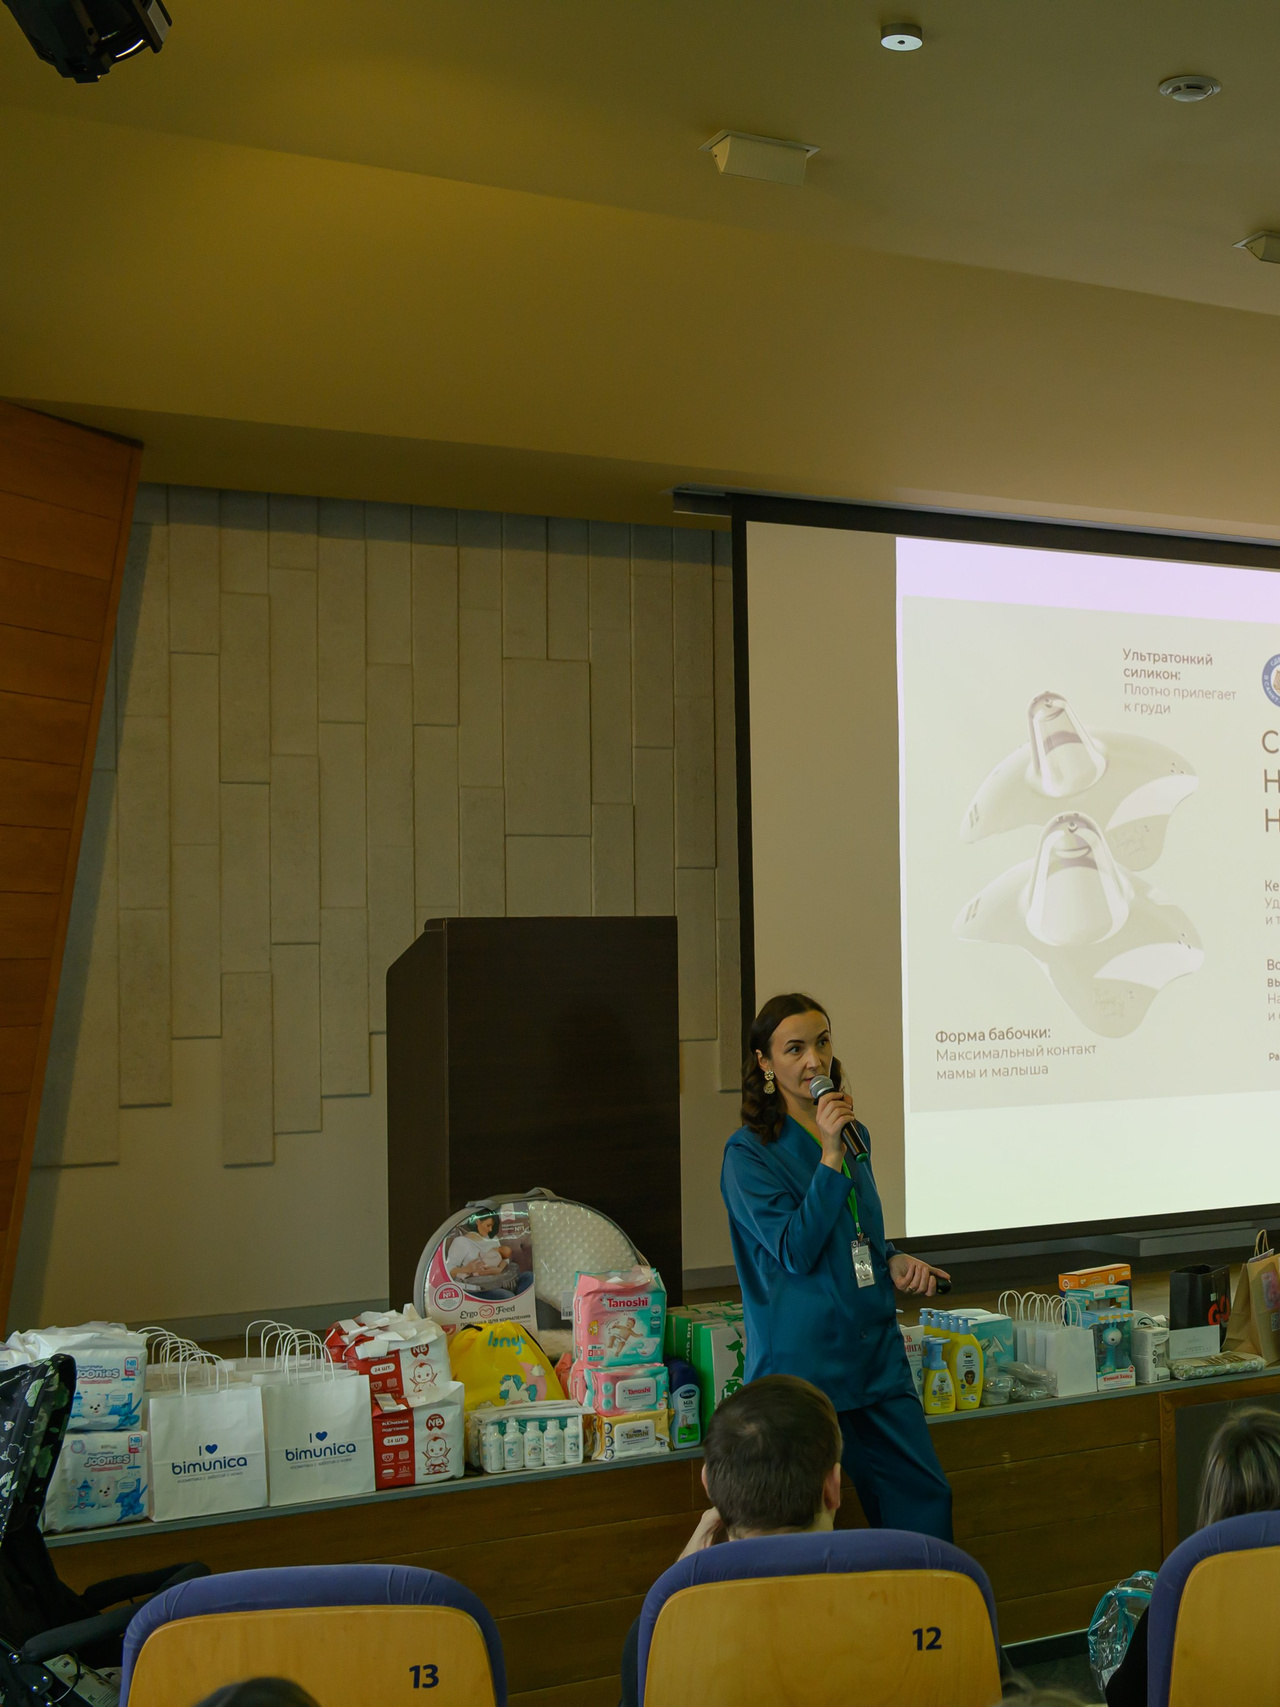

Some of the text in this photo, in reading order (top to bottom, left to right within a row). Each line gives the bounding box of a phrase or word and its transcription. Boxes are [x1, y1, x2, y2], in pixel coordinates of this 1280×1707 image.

[1123, 648, 1213, 666] Ультратонкий
[1123, 668, 1181, 680] силикон:
[1124, 683, 1237, 701] Плотно прилегает
[1124, 702, 1171, 715] к груди
[1265, 916, 1273, 925] и
[1268, 1012, 1275, 1021] и
[935, 1027, 1051, 1045] Форма бабочки:
[936, 1044, 1097, 1062] Максимальный контакт
[936, 1064, 1049, 1080] мамы и малыша
[607, 1297, 648, 1308] Tanoshi
[459, 1305, 516, 1320] Ergo Feed
[427, 1417, 443, 1428] NB
[309, 1432, 313, 1443] I
[199, 1445, 202, 1456] I
[285, 1443, 356, 1461] bimunica
[171, 1456, 247, 1475] bimunica
[912, 1626, 943, 1651] 12
[408, 1664, 440, 1689] 13
